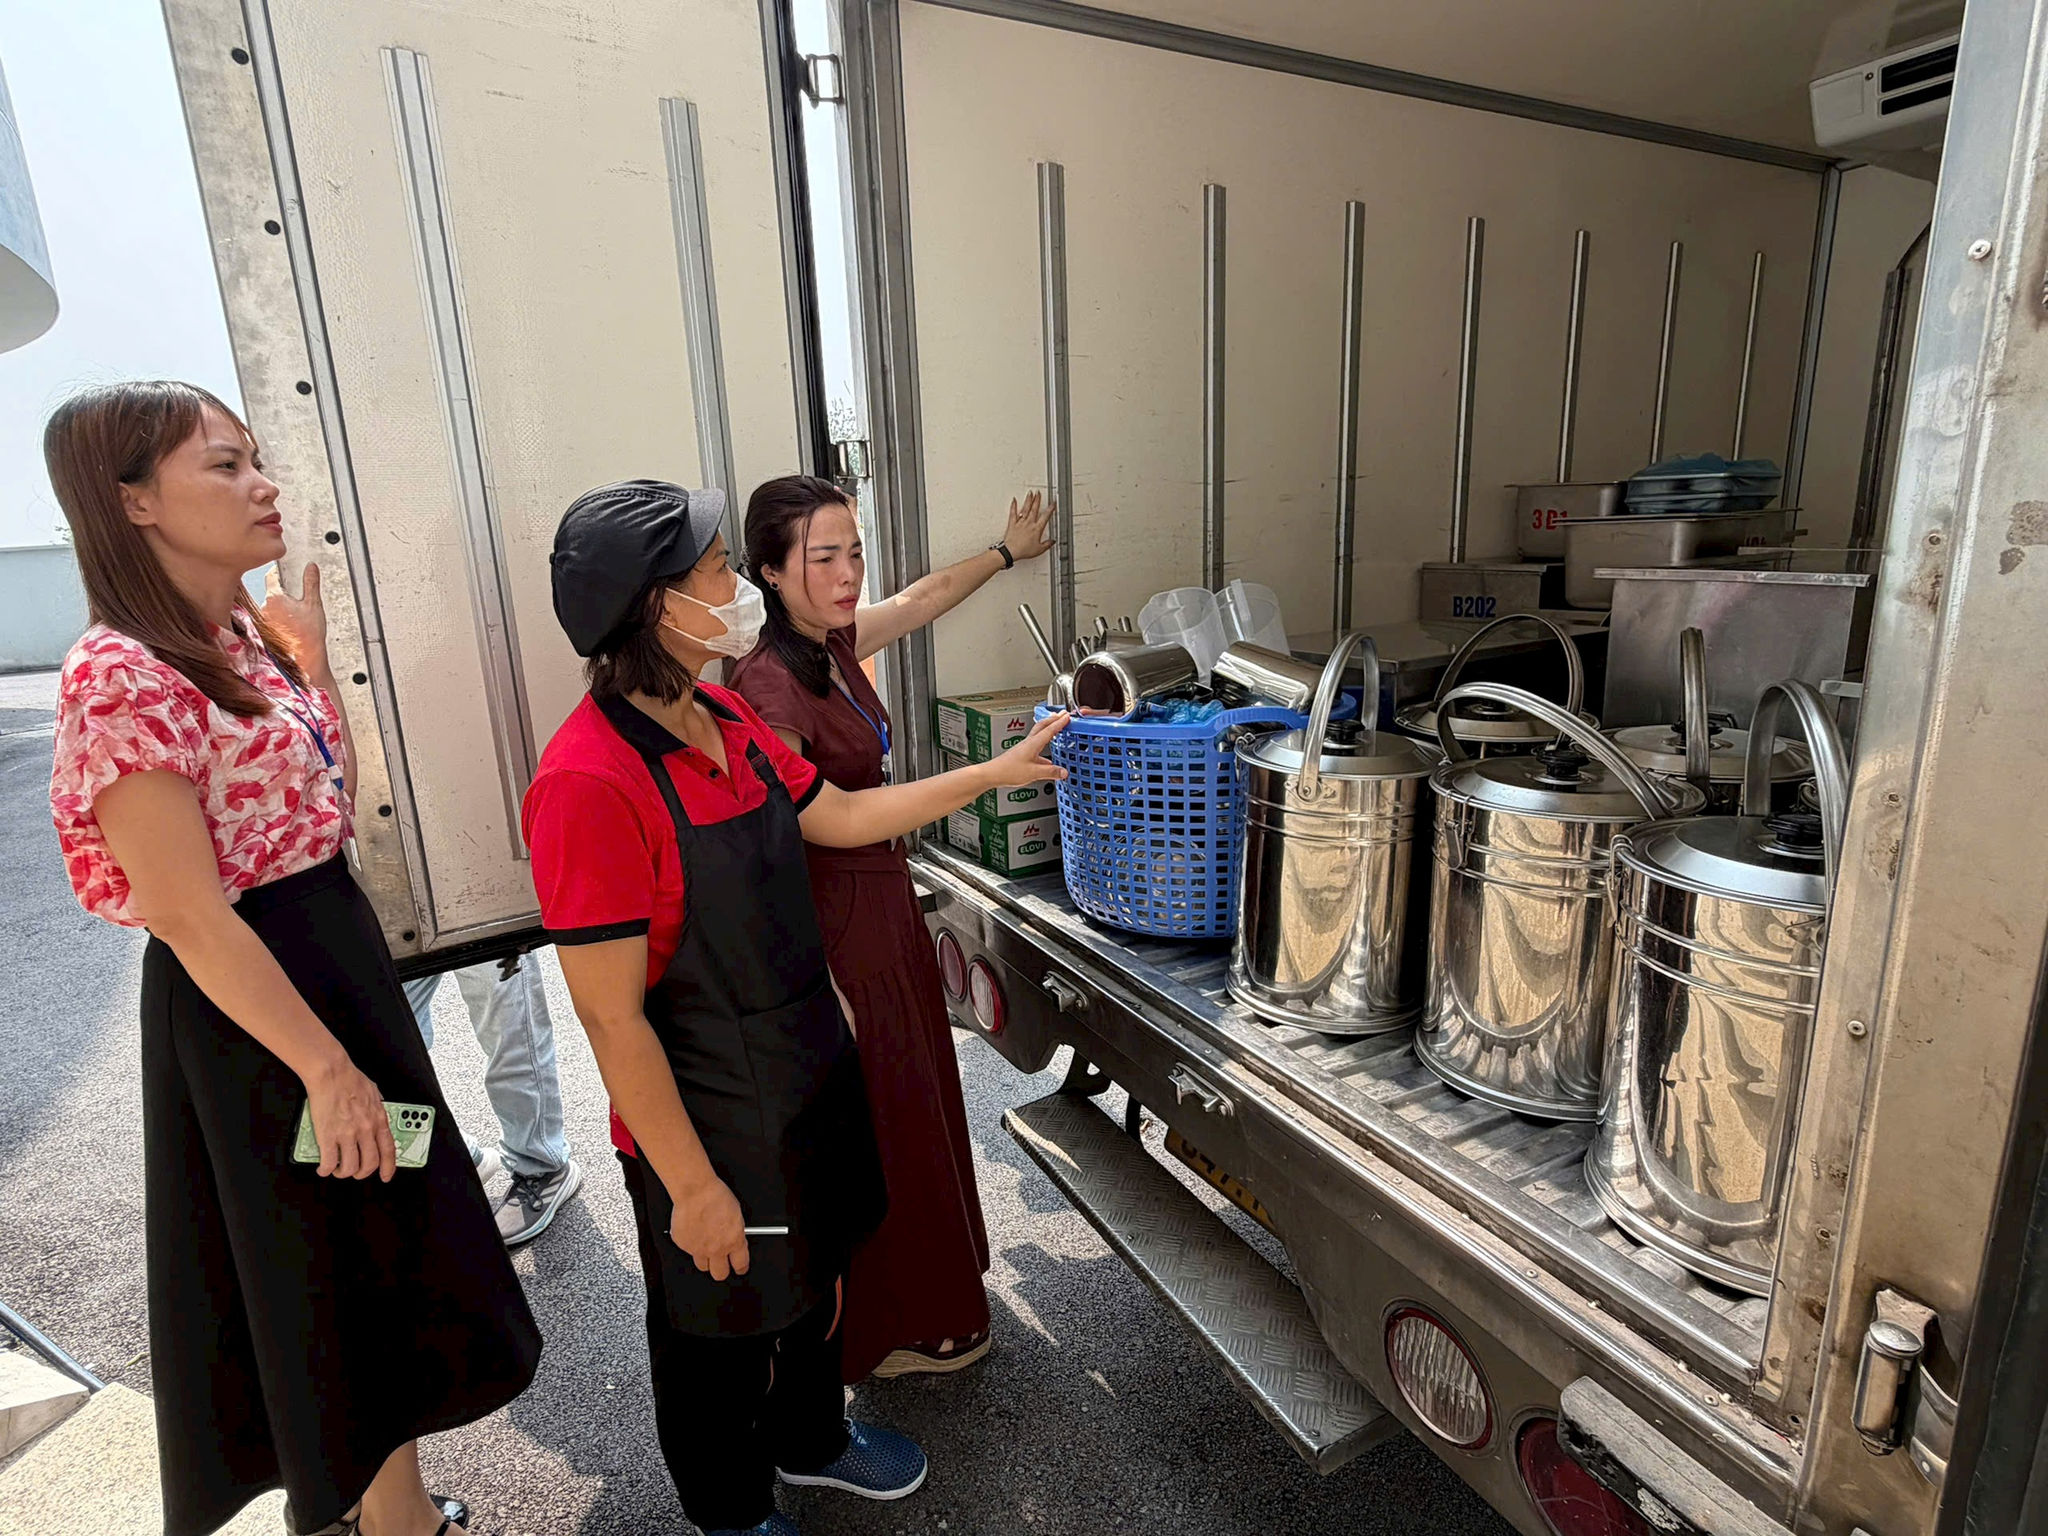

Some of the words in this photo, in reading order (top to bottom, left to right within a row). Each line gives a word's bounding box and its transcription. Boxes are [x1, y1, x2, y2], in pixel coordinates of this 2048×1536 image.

[1453, 595, 1497, 618] B202
[1009, 790, 1036, 801] ELOVI
[1020, 842, 1044, 854] ELOVI
